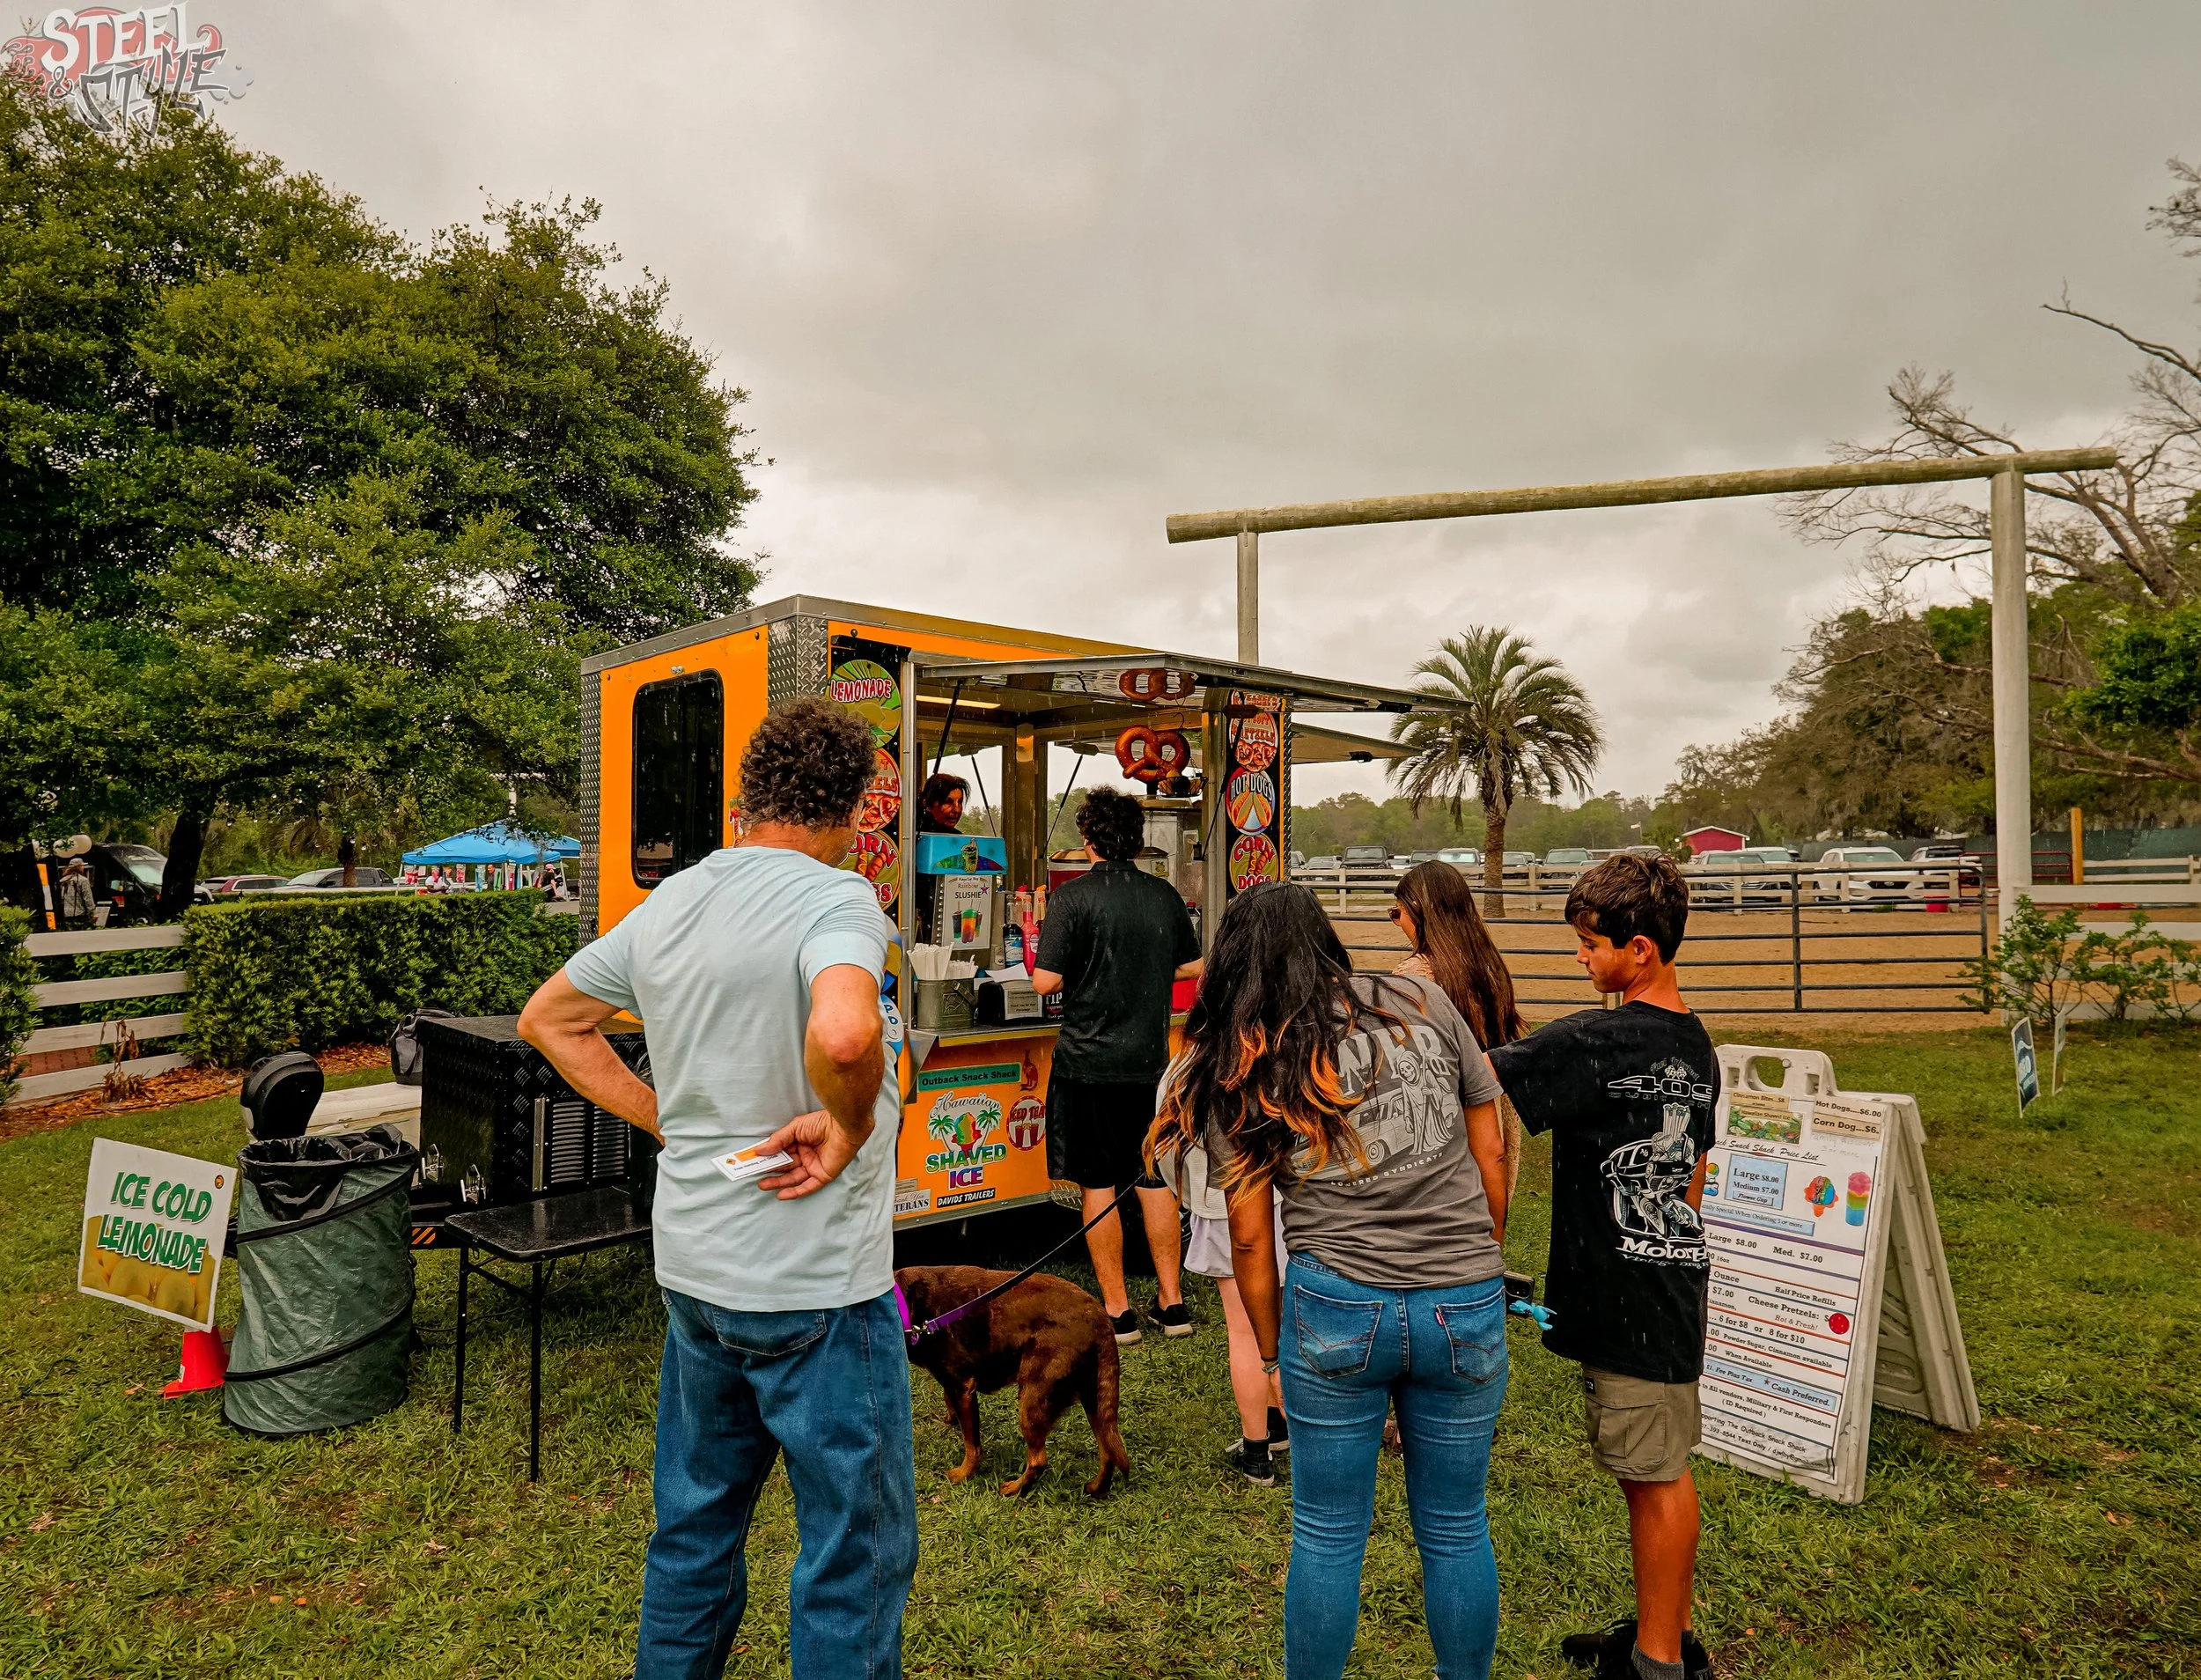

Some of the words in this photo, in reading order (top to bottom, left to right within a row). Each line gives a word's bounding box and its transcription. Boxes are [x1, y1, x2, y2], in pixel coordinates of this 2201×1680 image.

[830, 678, 892, 702] LEMONADE
[868, 776, 898, 791] ELS
[1231, 773, 1247, 799] HOT
[1250, 772, 1272, 800] DOGS
[1234, 836, 1275, 862] CORN
[922, 1073, 959, 1086] Outback
[962, 1071, 988, 1082] Snack
[990, 1068, 1017, 1079] Shack
[930, 1092, 1000, 1118] Hawaiian
[1814, 1117, 1835, 1127] Corn
[926, 1144, 1007, 1172] SHAVED
[1729, 1140, 1750, 1150] Snack
[1752, 1144, 1774, 1153] Shack
[1780, 1147, 1800, 1158] Price
[1801, 1152, 1819, 1161] List
[949, 1167, 983, 1189] ICE
[1330, 1175, 1379, 1187] LOWERED
[1383, 1153, 1443, 1177] SYNDICATE
[1734, 1168, 1760, 1182] Large
[1762, 1174, 1779, 1183] $8.00
[111, 1171, 151, 1209] ICE
[151, 1181, 213, 1223] COLD
[938, 1195, 962, 1206] DAVIDS
[964, 1189, 995, 1201] TRAILERS
[1733, 1181, 1760, 1192] Medium
[1761, 1186, 1779, 1195] $7.00
[1752, 1213, 1778, 1224] Ordering
[97, 1214, 208, 1274] LEMONADE
[1735, 1238, 1757, 1249] $8.00
[1773, 1247, 1795, 1257] Med.
[1800, 1251, 1823, 1263] $7.00
[1714, 1271, 1740, 1283] Ounce
[1792, 1291, 1810, 1301] Price
[1812, 1295, 1837, 1306] Refills
[1712, 1286, 1734, 1298] $7.00
[1748, 1295, 1778, 1310] Cheese
[1781, 1303, 1819, 1320] Pretzels:
[1726, 1316, 1738, 1326] for
[1776, 1330, 1788, 1339] for
[1791, 1334, 1805, 1344] $10
[1795, 1321, 1818, 1330] Fresh!
[1723, 1333, 1746, 1345] Powder
[1747, 1339, 1766, 1350] Sugar,
[1768, 1345, 1800, 1359] Cinnamon
[1802, 1355, 1832, 1368] available
[1726, 1350, 1742, 1360] When
[1743, 1355, 1772, 1368] Available
[1727, 1370, 1741, 1379] Plus
[1771, 1382, 1791, 1394] Cash
[1792, 1389, 1830, 1407] Preferred.
[1719, 1387, 1745, 1402] vendors,
[1747, 1396, 1771, 1411] Military
[1779, 1406, 1793, 1417] First
[1794, 1411, 1831, 1429] Responders
[1728, 1420, 1739, 1430] The
[1741, 1426, 1765, 1439] Outback
[1768, 1434, 1785, 1446] Snack
[1787, 1441, 1807, 1453] Shack
[1738, 1435, 1752, 1444] Text
[1752, 1441, 1766, 1451] Only
